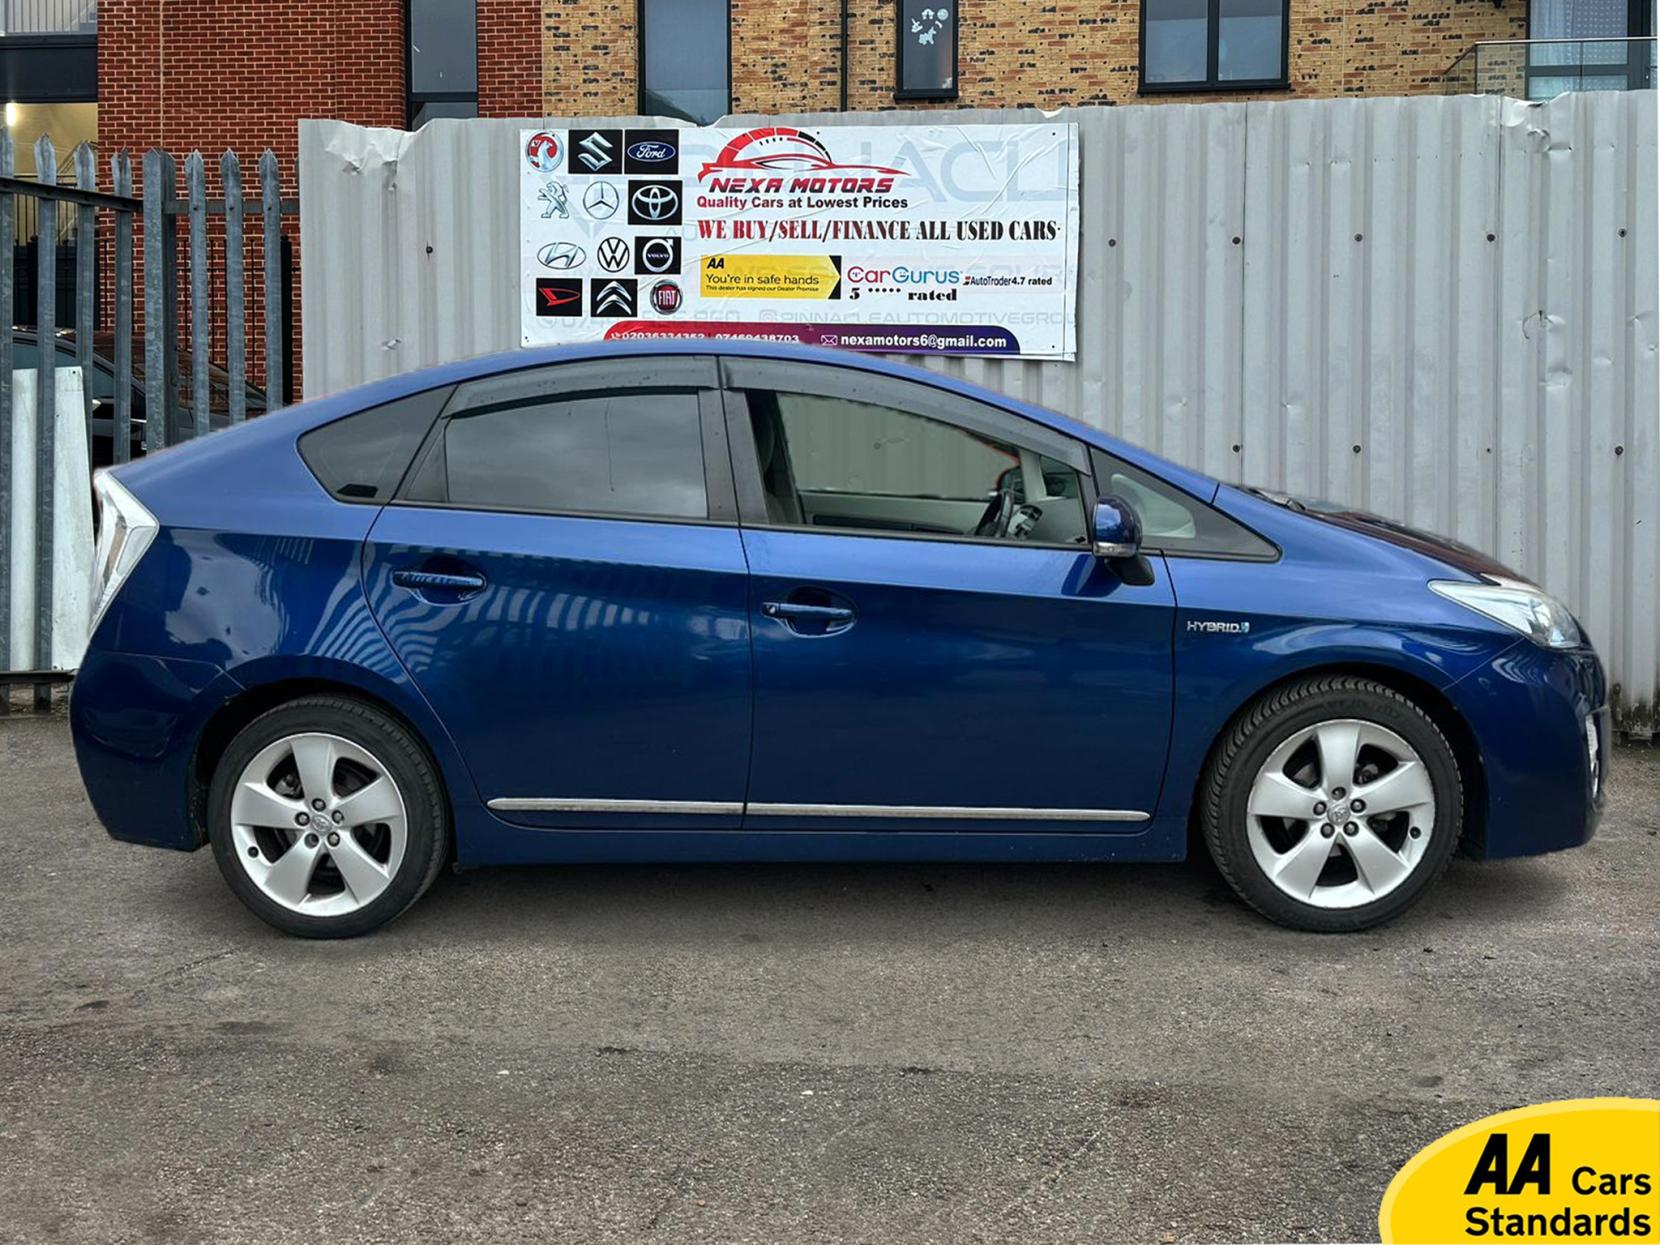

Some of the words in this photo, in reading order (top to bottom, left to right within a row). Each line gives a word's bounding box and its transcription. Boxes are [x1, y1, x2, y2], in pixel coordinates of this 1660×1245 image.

[636, 144, 666, 159] Ford
[709, 178, 783, 193] NEXA
[789, 178, 894, 193] MOTORS
[697, 196, 748, 210] Quality
[752, 196, 784, 208] Cars
[789, 197, 803, 208] at
[807, 196, 858, 208] Lowest
[863, 196, 908, 208] Prices
[697, 220, 726, 239] WE
[917, 220, 950, 240] ALL
[956, 220, 1003, 240] USED
[1009, 220, 1056, 240] CARS
[706, 257, 725, 269] AA
[706, 273, 741, 284] You're
[744, 273, 754, 284] in
[757, 274, 781, 285] safe
[784, 274, 820, 285] hands
[847, 266, 959, 284] CarGurus
[1028, 277, 1052, 286] rated
[658, 290, 676, 305] FIAT
[849, 287, 860, 300] 5
[908, 288, 957, 301] rated
[841, 335, 1007, 349] nexamotors6@gmail.com
[1187, 620, 1240, 633] HYBRID
